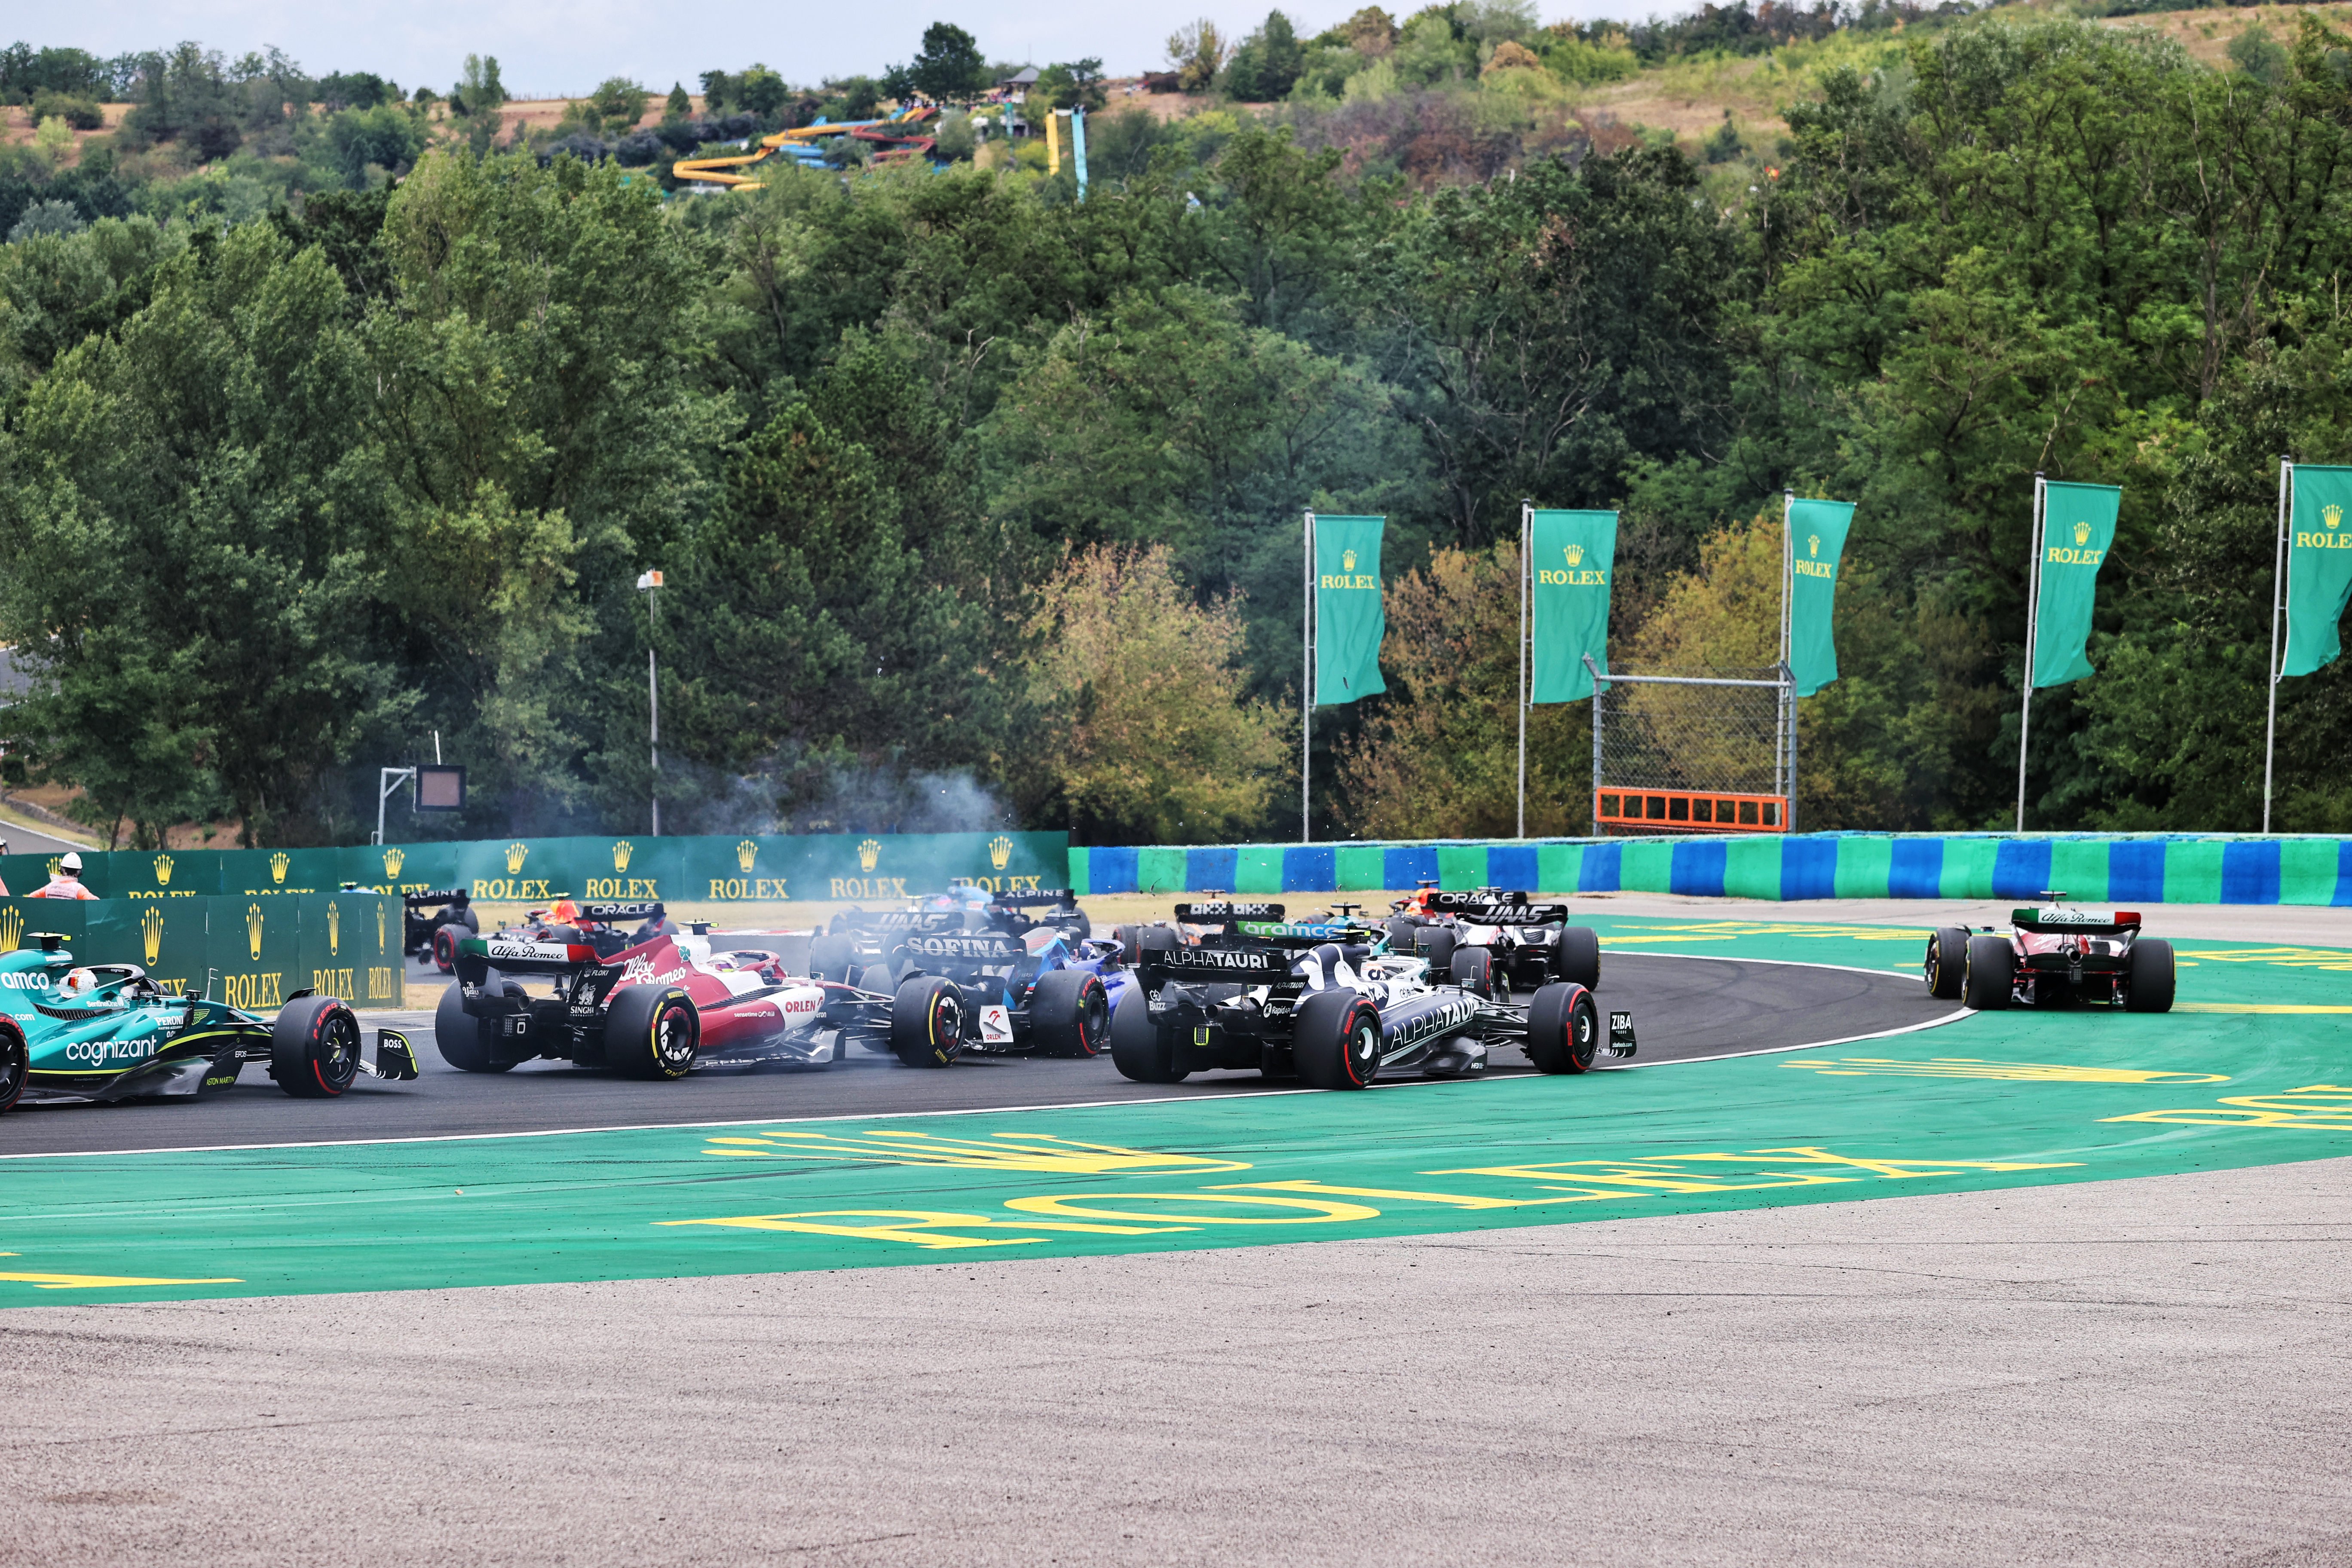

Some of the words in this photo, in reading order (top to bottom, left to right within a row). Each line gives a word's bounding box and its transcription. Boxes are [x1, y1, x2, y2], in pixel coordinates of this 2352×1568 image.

[2296, 532, 2352, 549] ROLE
[2047, 548, 2103, 565] ROLEX
[1795, 559, 1832, 579] ROLEX
[1321, 575, 1375, 589] ROLEX
[1538, 570, 1605, 585] ROLEX
[409, 889, 458, 899] ALPINE
[471, 879, 551, 900] ROLEX
[585, 879, 659, 899] ROLEX
[709, 879, 790, 899] ROLEX
[830, 878, 907, 898] ROLEX
[1005, 889, 1065, 898] ALPINE
[591, 903, 655, 916] ORACLE
[1468, 906, 1553, 923] HAAS
[2041, 913, 2068, 924] Alfa
[2070, 913, 2112, 924] Romeo
[1244, 924, 1338, 937] aramco
[491, 945, 521, 959] Alfa
[522, 946, 564, 959] Romeo
[907, 937, 1013, 958] SOFINA
[1164, 950, 1268, 968] ALPHATAURI
[0, 972, 50, 990] amco
[313, 968, 354, 1001] ROLEX
[368, 966, 392, 1000] ROLEX
[467, 981, 475, 989] 30
[225, 972, 282, 1010] ROLEX
[462, 986, 479, 998] Years
[570, 1006, 594, 1014] SINGHA
[785, 1000, 816, 1013] ORLEN
[1149, 1000, 1166, 1011] BUZZ
[154, 1015, 184, 1026] PERONI
[1390, 997, 1474, 1050] ALPHATAUR
[1611, 1015, 1632, 1030] ZIBA
[66, 1035, 157, 1067] cognizant
[383, 1038, 402, 1049] BOSS
[206, 1078, 219, 1086] ASTON
[219, 1076, 236, 1084] MARTIN
